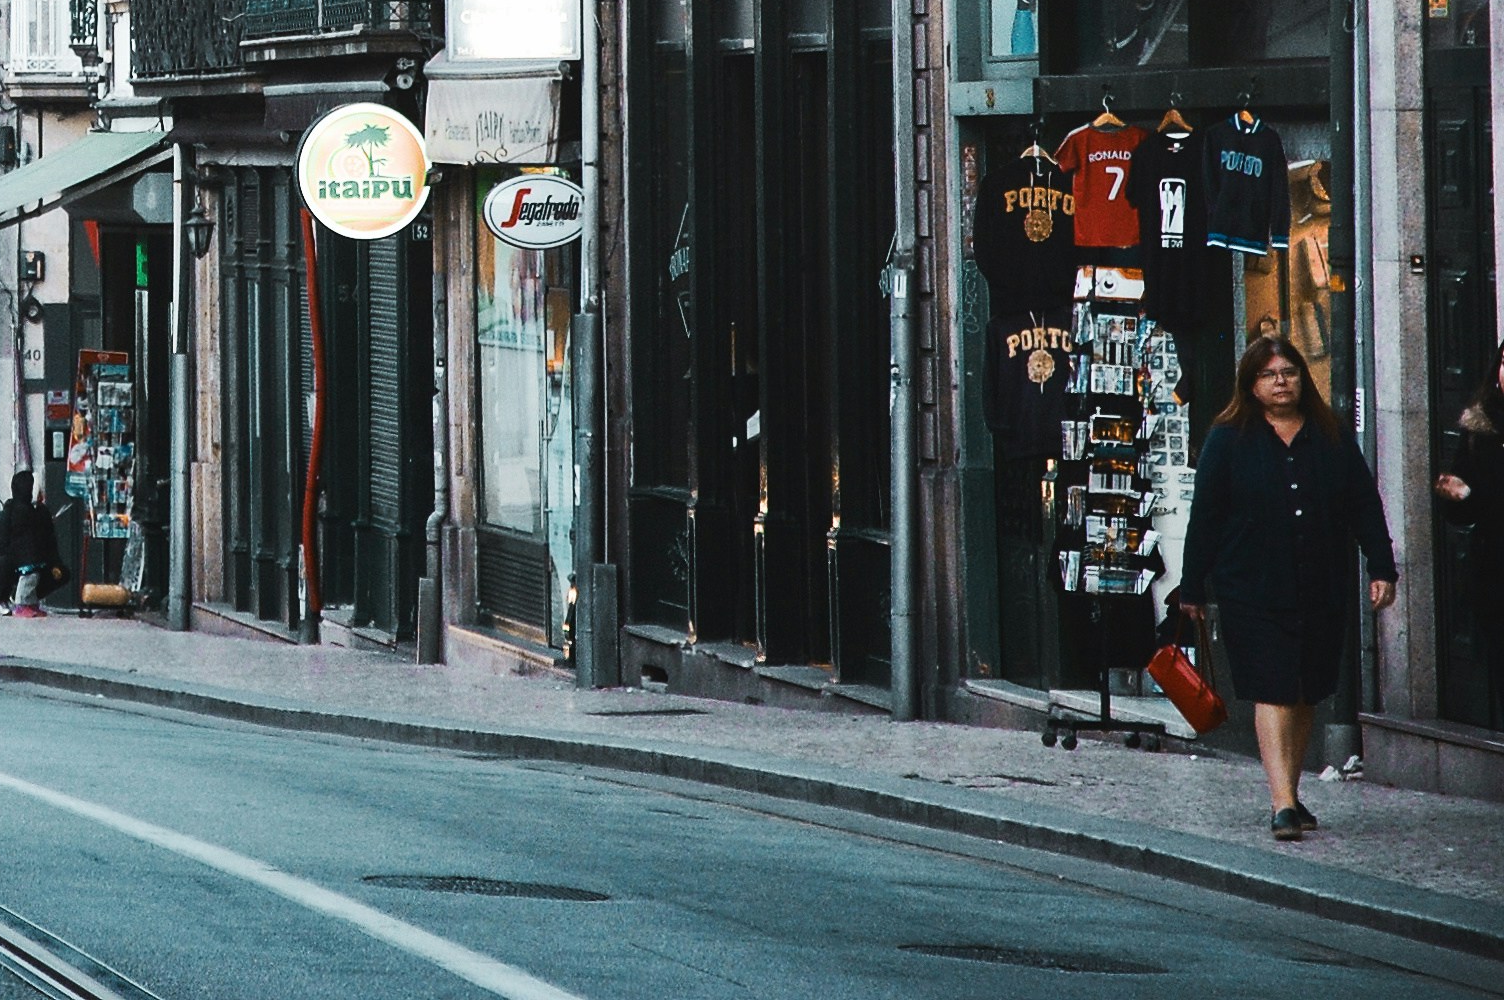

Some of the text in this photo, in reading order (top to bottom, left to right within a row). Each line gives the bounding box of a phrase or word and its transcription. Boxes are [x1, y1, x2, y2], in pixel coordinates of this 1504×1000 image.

[1105, 166, 1125, 201] 7
[500, 188, 580, 228] Segafredo
[1003, 187, 1075, 215] PORTO
[416, 225, 428, 239] 52
